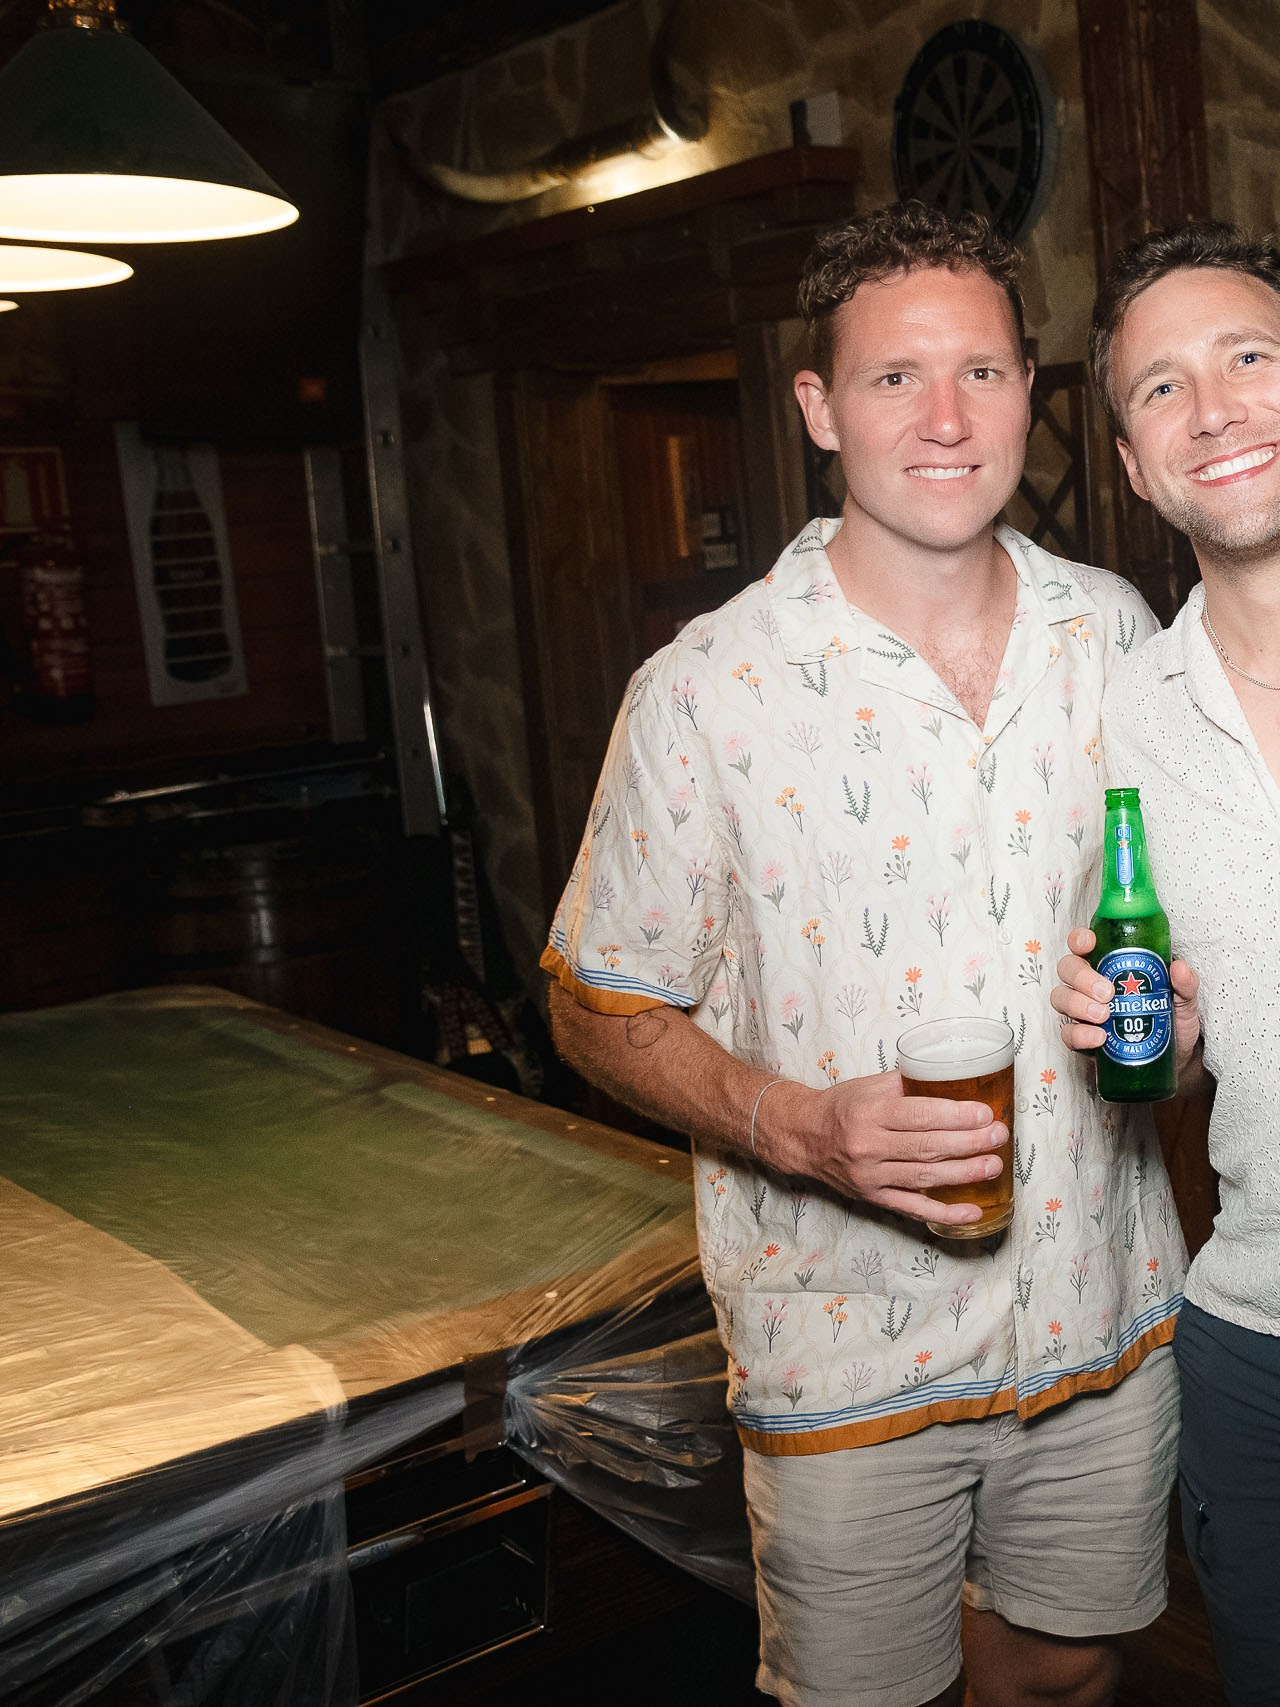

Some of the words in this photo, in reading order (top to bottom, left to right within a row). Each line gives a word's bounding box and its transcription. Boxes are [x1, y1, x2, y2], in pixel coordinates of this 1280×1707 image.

[1104, 960, 1132, 980] EINEKEN
[1147, 964, 1161, 982] BEER
[1109, 996, 1168, 1014] eineken
[1123, 1017, 1144, 1033] 0.0
[1106, 1031, 1120, 1050] PURE
[1123, 1045, 1143, 1053] MALT
[1146, 1028, 1164, 1050] LAGER
